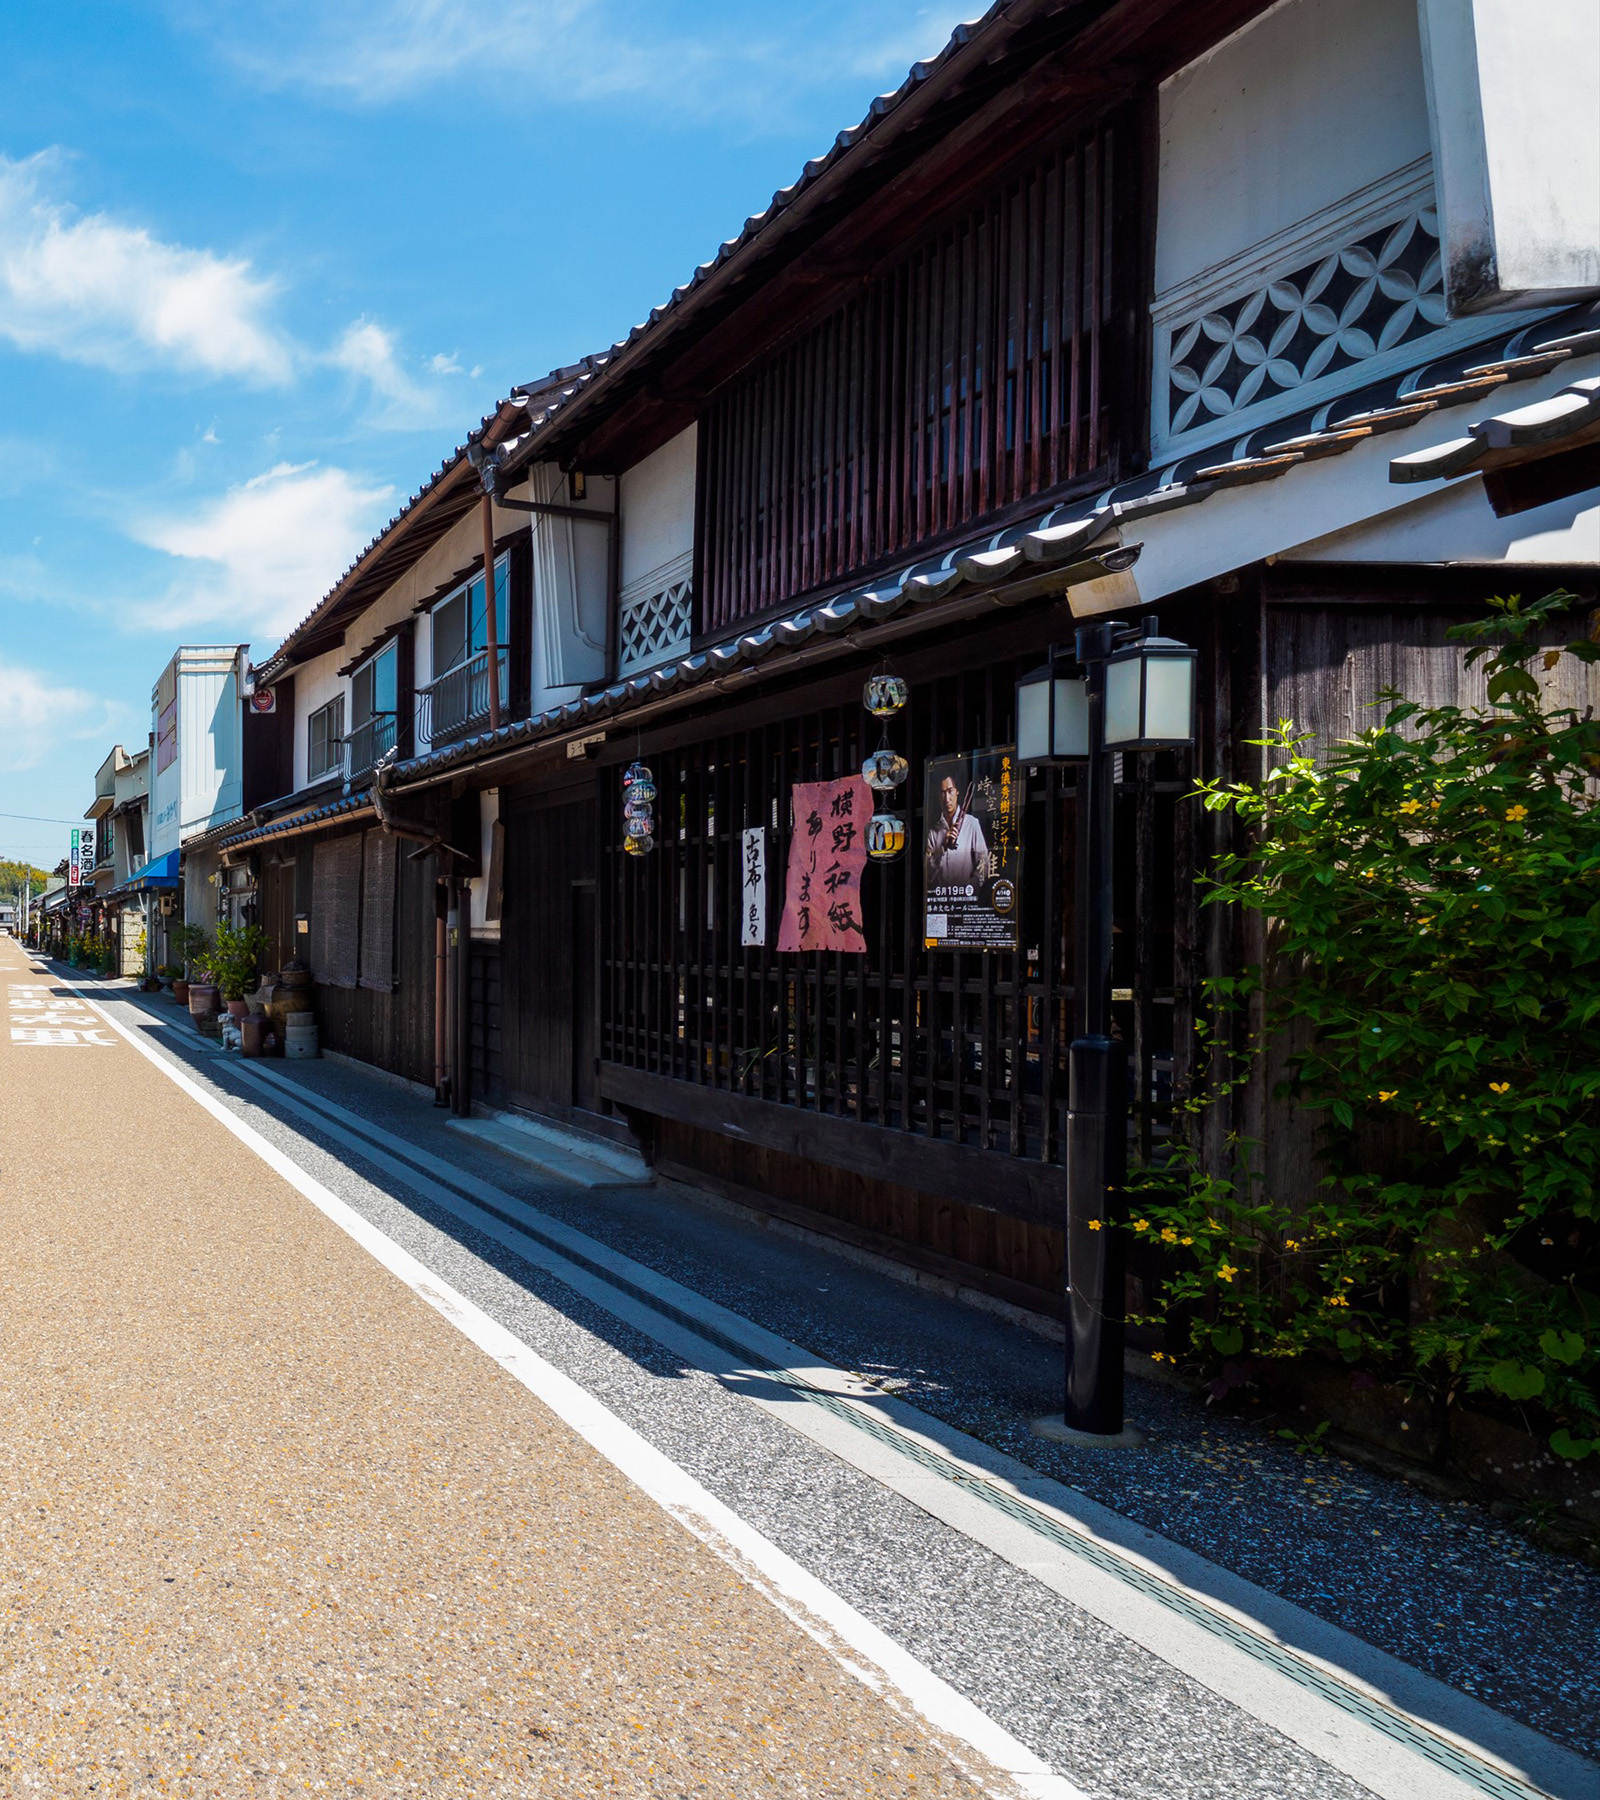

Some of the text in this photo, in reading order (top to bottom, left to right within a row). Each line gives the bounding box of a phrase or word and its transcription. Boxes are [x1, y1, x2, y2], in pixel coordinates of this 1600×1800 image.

[798, 811, 823, 939] あります
[824, 787, 863, 934] 横野和紙
[999, 756, 1012, 868] 東儀秀樹コンサート
